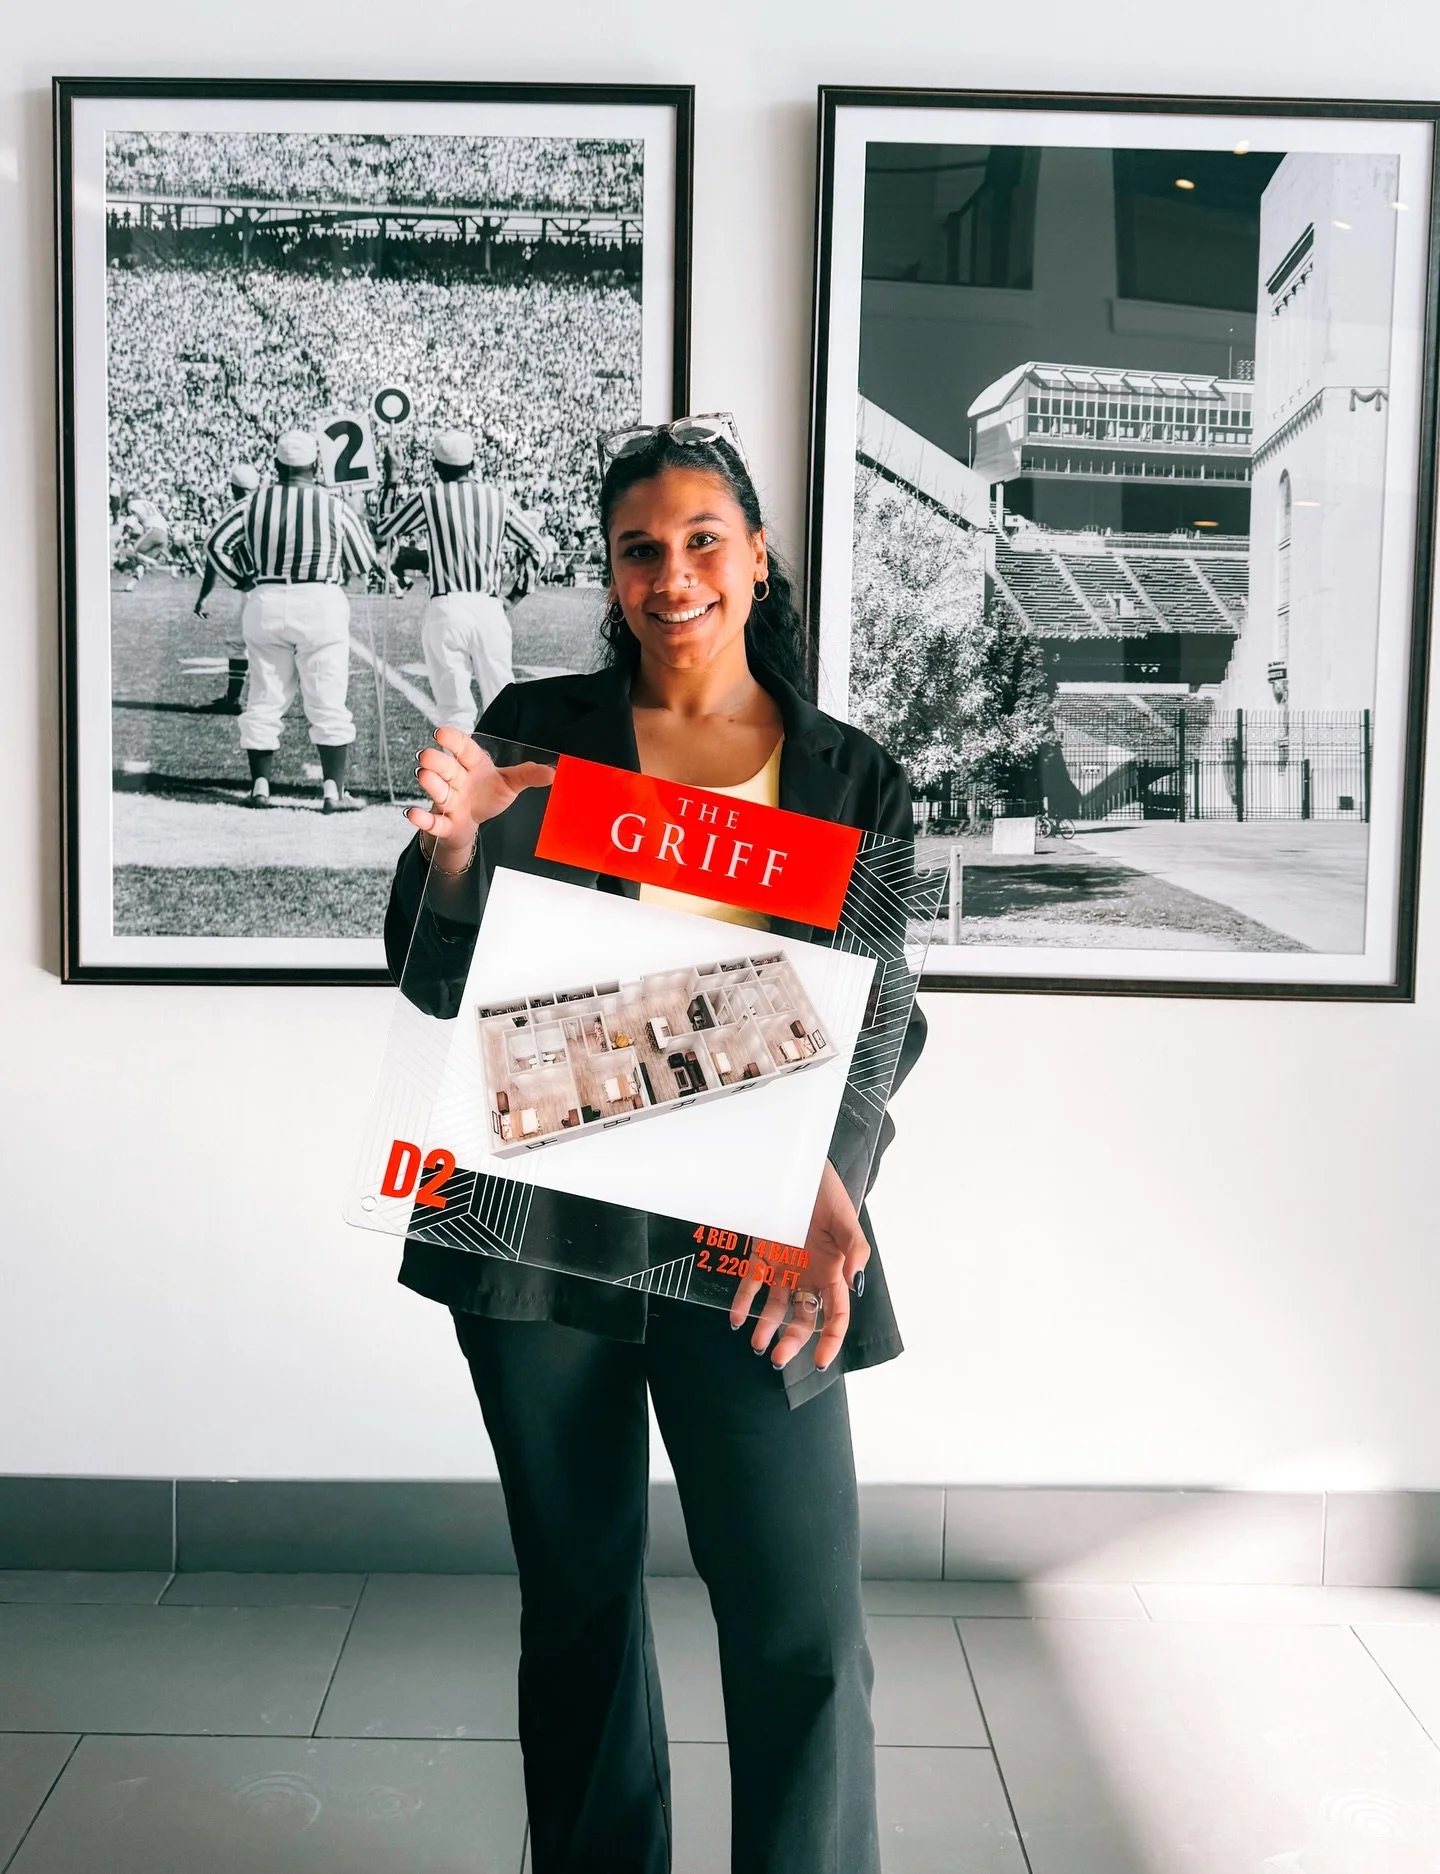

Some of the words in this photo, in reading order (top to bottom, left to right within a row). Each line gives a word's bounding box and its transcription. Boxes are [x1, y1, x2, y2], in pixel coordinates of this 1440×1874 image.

[324, 420, 369, 482] 2
[678, 797, 740, 830] THE
[610, 813, 789, 888] GRIFF
[380, 1140, 456, 1209] D2
[693, 1225, 705, 1243] 4
[706, 1227, 738, 1251] BED
[755, 1241, 767, 1259] 4
[768, 1244, 810, 1269] BATH
[716, 1254, 750, 1278] 220
[752, 1263, 777, 1286] SQ.
